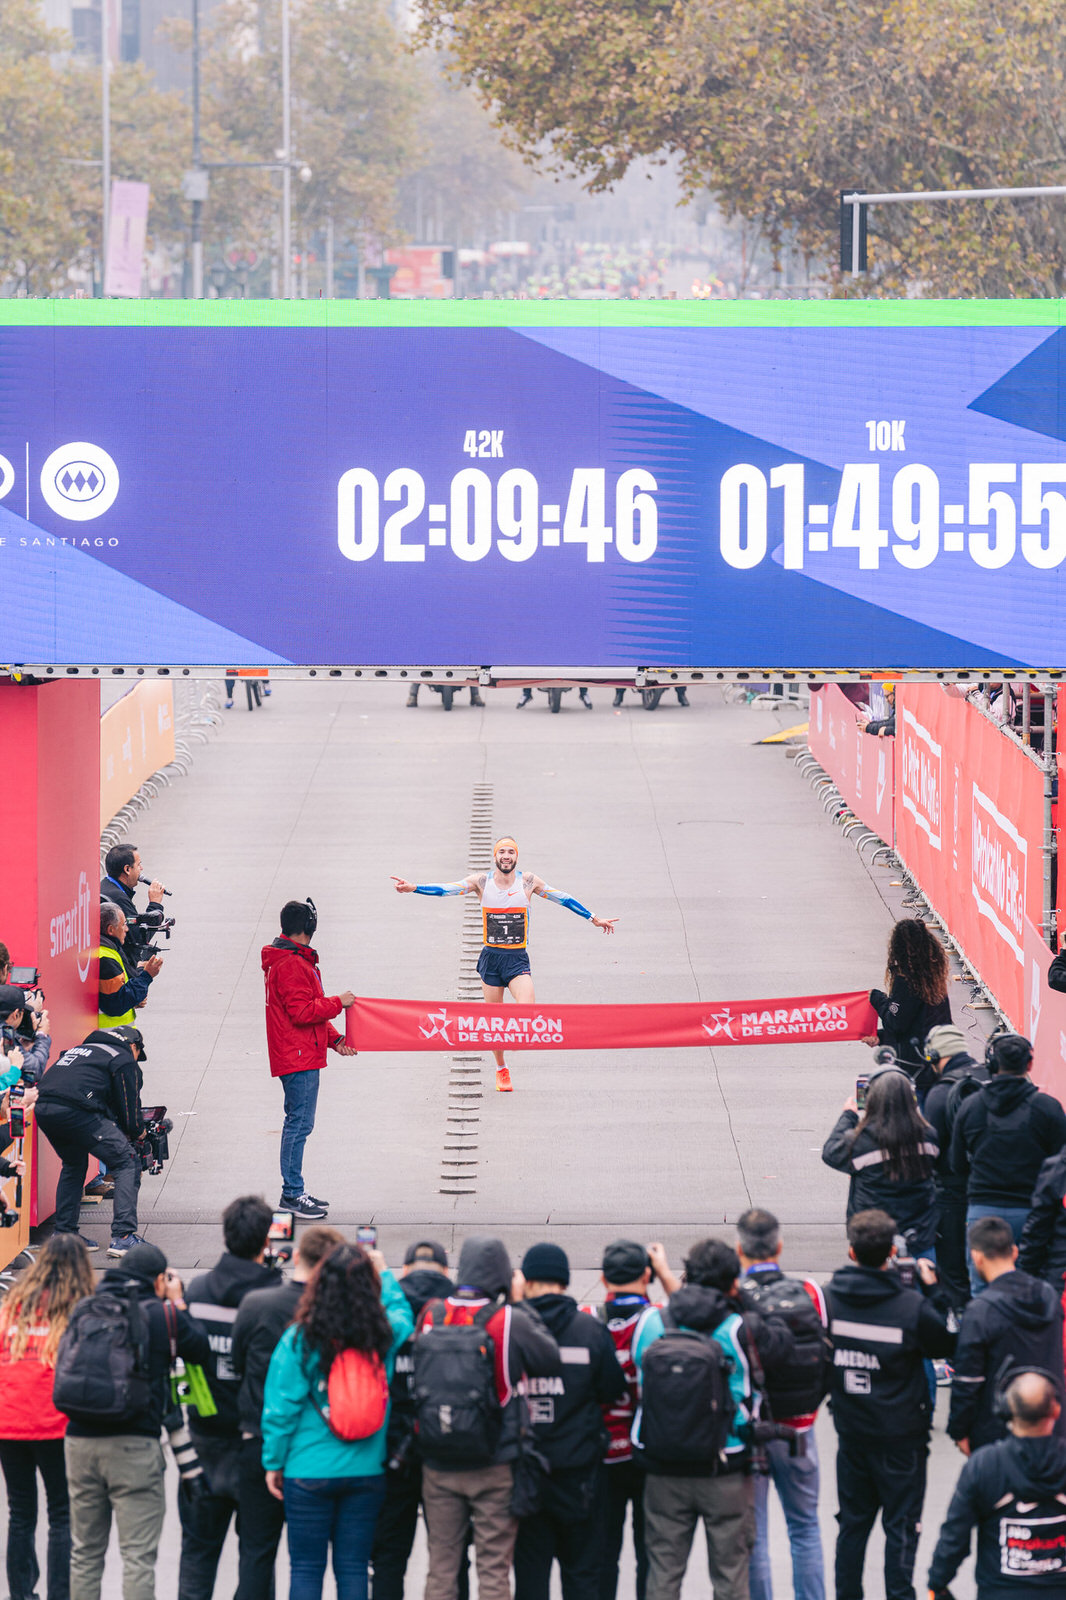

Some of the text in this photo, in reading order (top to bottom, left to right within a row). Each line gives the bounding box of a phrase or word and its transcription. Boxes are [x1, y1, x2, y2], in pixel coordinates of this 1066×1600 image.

[463, 429, 504, 458] 42K
[865, 420, 906, 451] 10K
[337, 467, 658, 562] 02:09:46
[719, 463, 1066, 569] 01:49:55
[20, 537, 119, 547] SANTIAGO
[502, 925, 508, 935] 1
[458, 1014, 563, 1033] MARATÓN
[741, 1003, 847, 1026] MARATÓN
[458, 1031, 564, 1043] DE SANTIAGO
[742, 1019, 849, 1037] DE SANTIAGO
[834, 1349, 880, 1370] MEDIA
